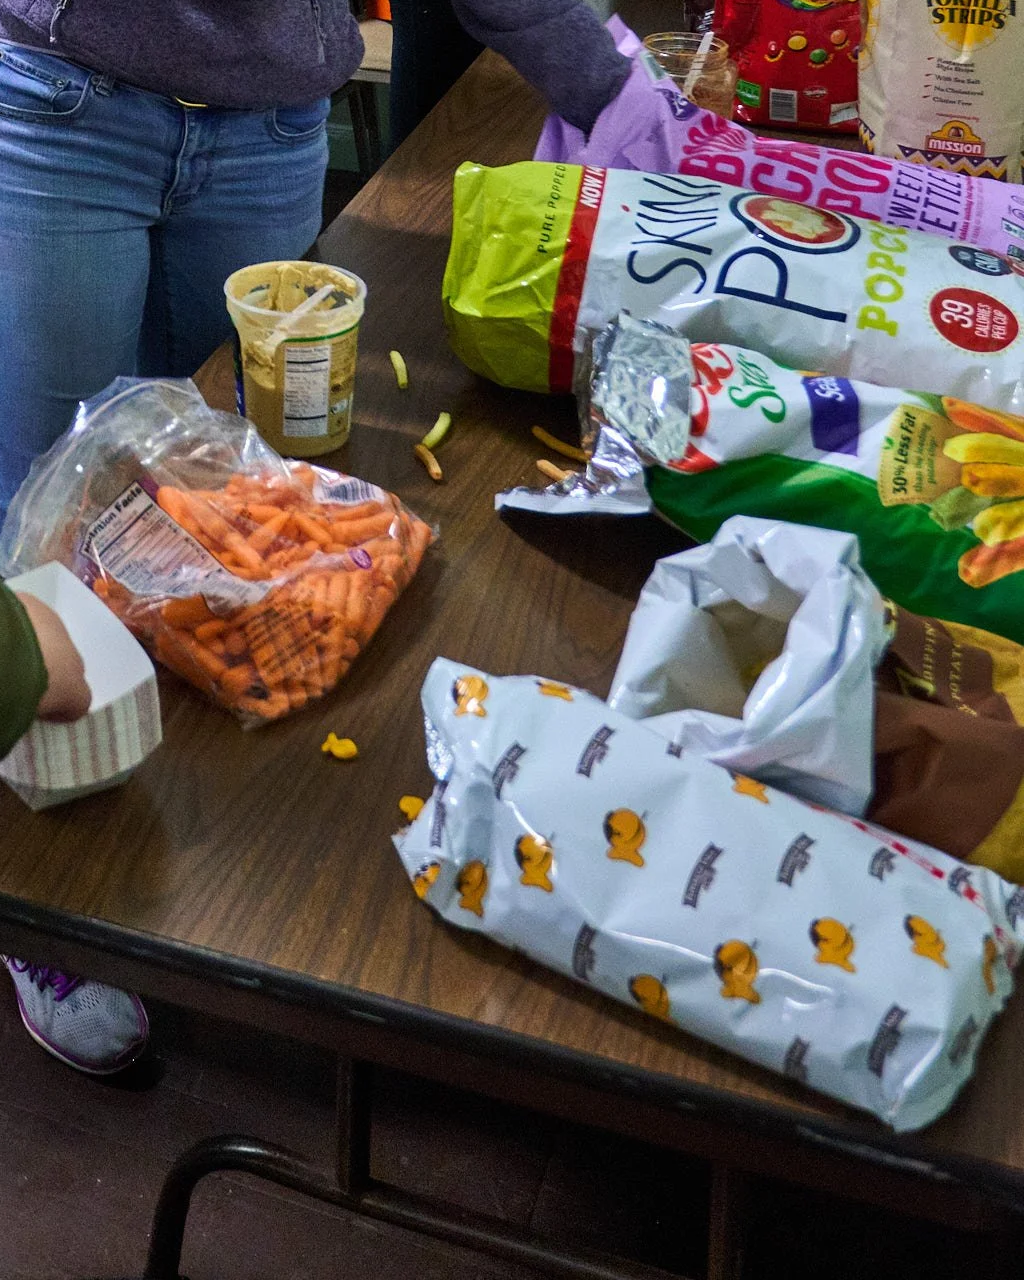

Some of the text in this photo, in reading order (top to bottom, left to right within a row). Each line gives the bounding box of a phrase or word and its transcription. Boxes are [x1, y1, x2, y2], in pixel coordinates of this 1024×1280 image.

[932, 7, 1007, 29] STRIPS
[537, 164, 566, 254] PURE POPPED
[579, 174, 604, 209] NOW
[886, 168, 924, 228] WEET
[917, 171, 962, 238] ETTLE
[621, 173, 722, 294] SKIN
[940, 298, 974, 329] 39
[974, 302, 992, 338] CALORIES
[991, 308, 1009, 340] PER CUP
[892, 412, 917, 494] 30% Less Fat
[114, 486, 143, 513] Facts
